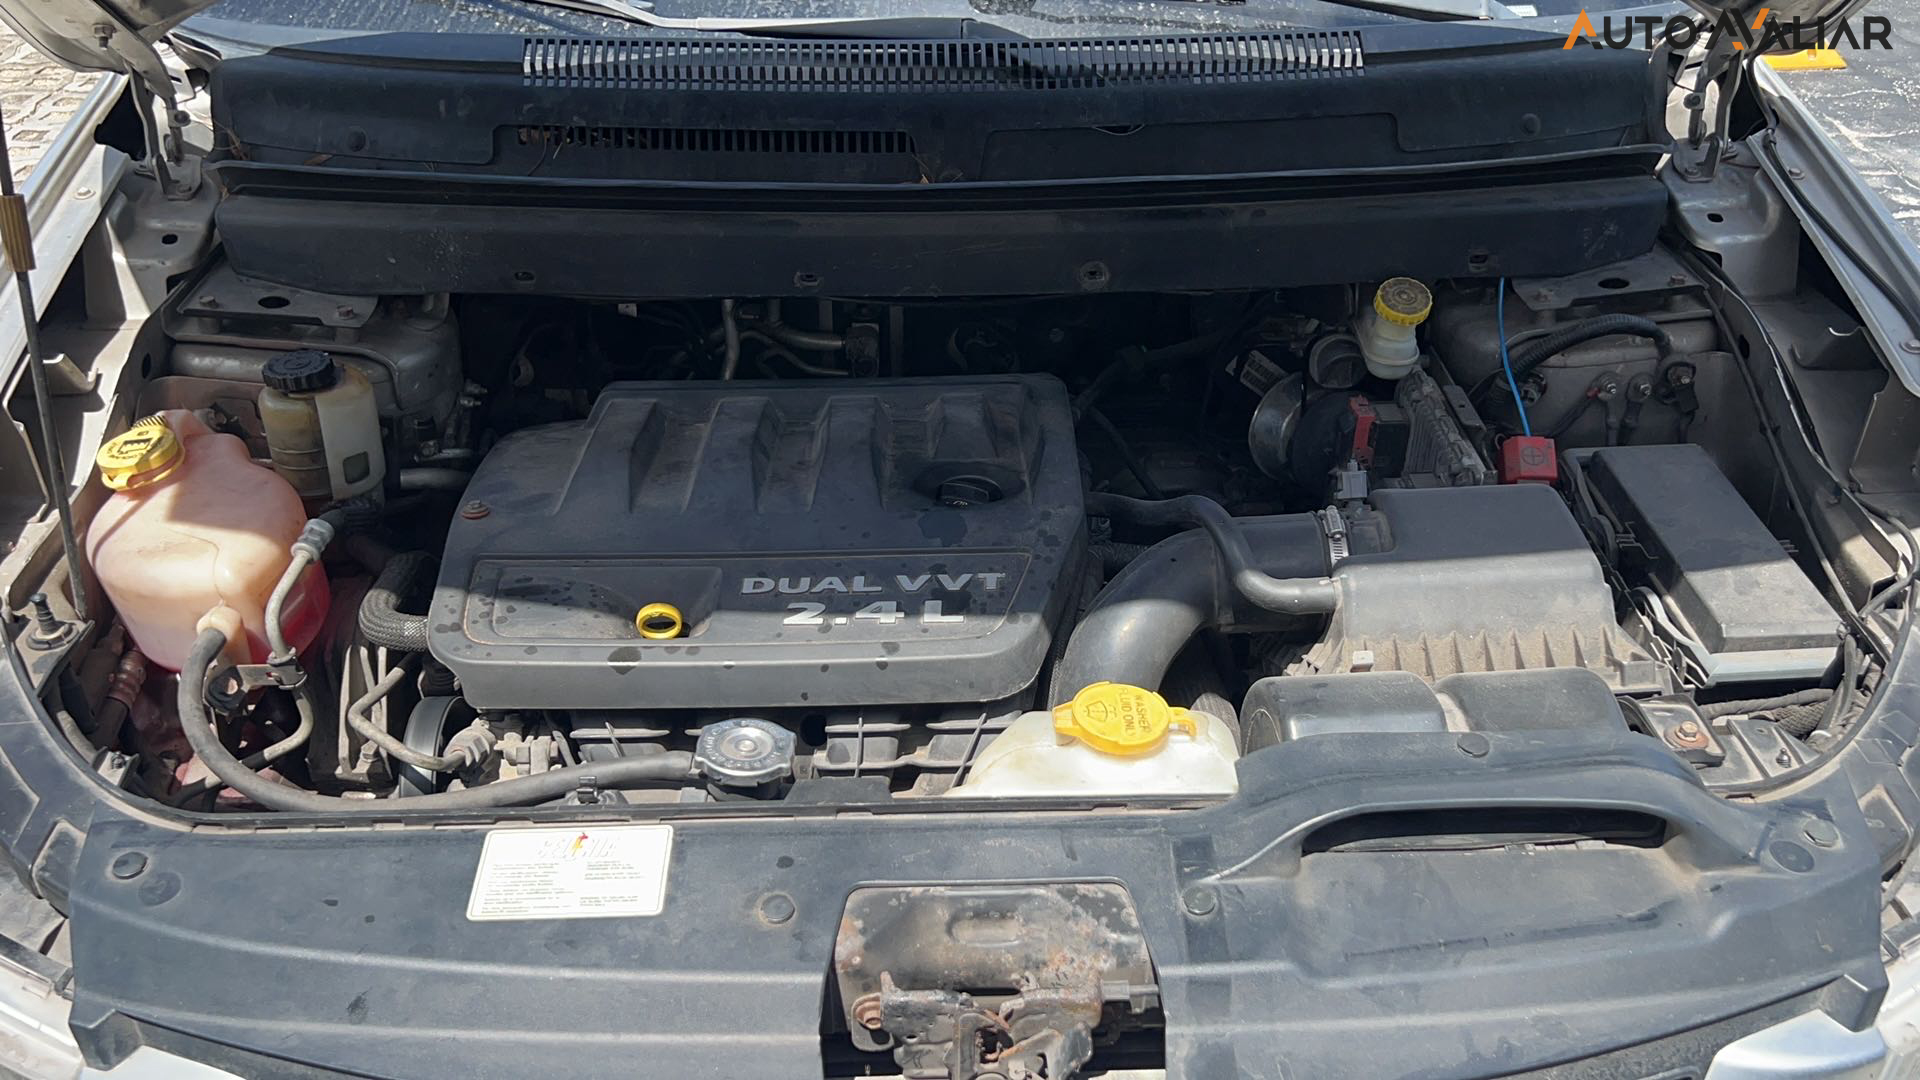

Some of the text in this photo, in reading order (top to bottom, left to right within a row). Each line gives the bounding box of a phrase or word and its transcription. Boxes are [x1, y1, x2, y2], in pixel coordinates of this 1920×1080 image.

[742, 573, 1007, 594] DUAL VVT
[783, 600, 965, 625] 2.4 L
[1119, 689, 1132, 712] FLUID
[1135, 695, 1152, 733] WASHER
